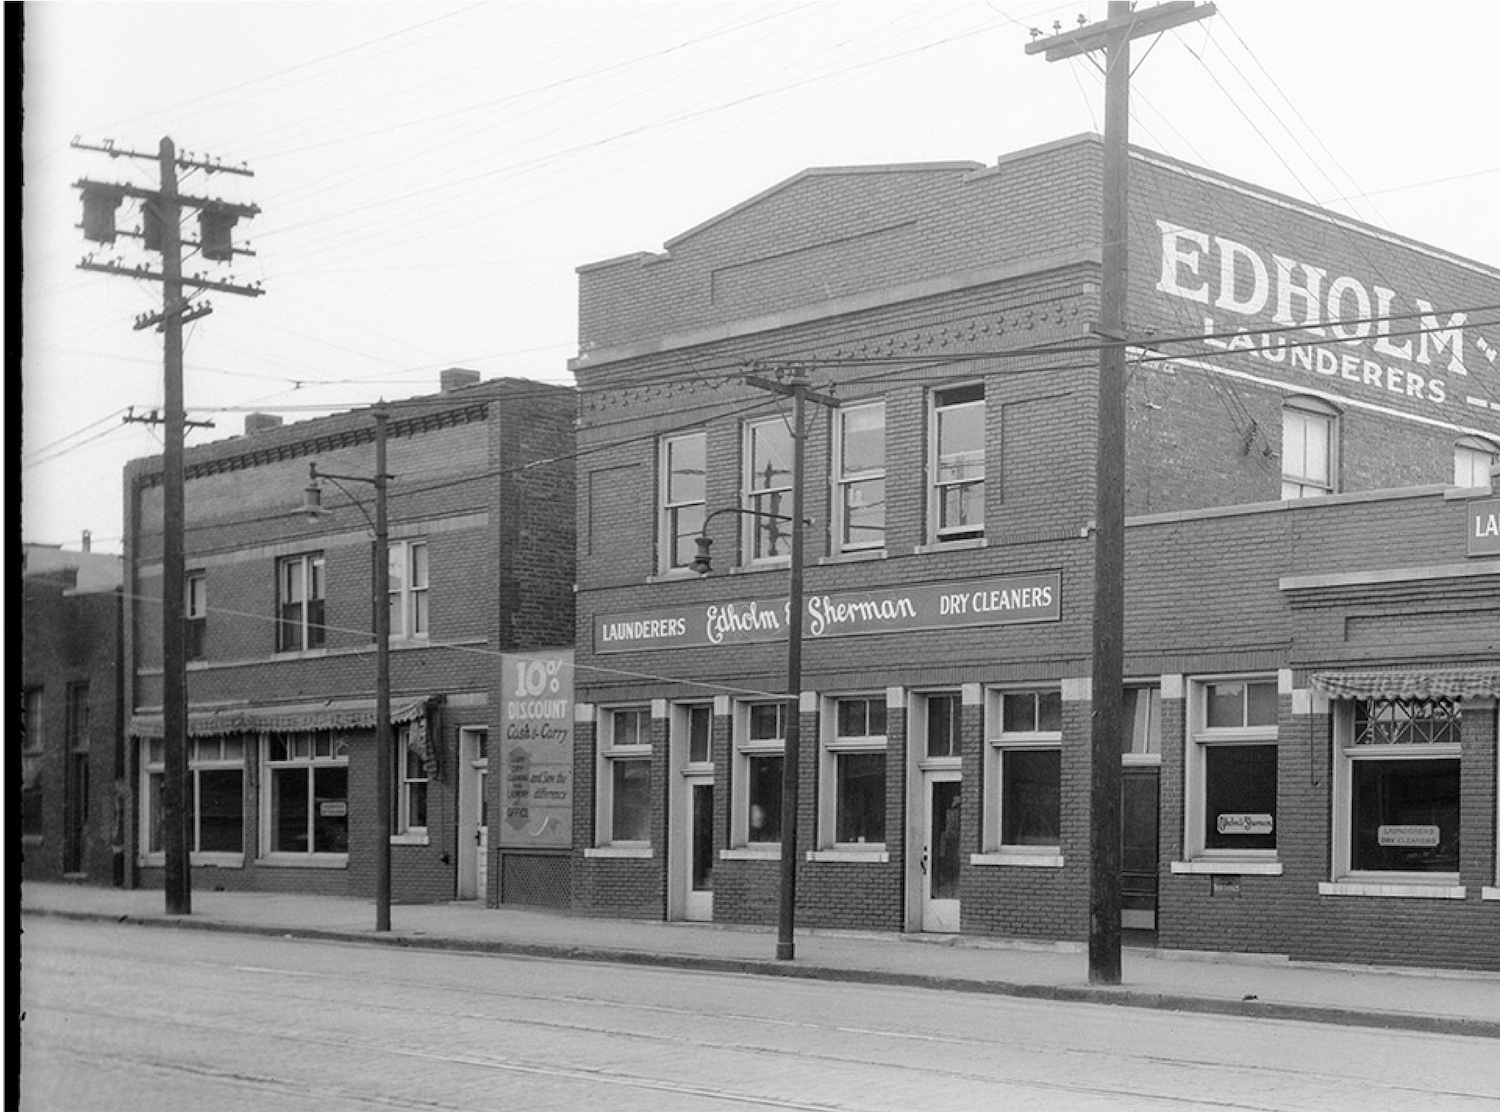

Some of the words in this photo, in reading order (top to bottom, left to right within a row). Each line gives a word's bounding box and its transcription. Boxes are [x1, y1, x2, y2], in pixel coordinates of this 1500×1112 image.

[1156, 219, 1468, 377] EDHOLM
[1203, 316, 1447, 404] LAUNDERERS
[602, 617, 687, 642] LAUNDERERS
[706, 602, 780, 645] Edholm
[807, 596, 917, 636] Sherman
[940, 594, 970, 615] DRY
[972, 586, 1054, 613] CLEANERS
[515, 659, 564, 697] 10%
[507, 699, 569, 719] DISCOUNT
[507, 723, 530, 740] Cash
[541, 723, 568, 744] Carry
